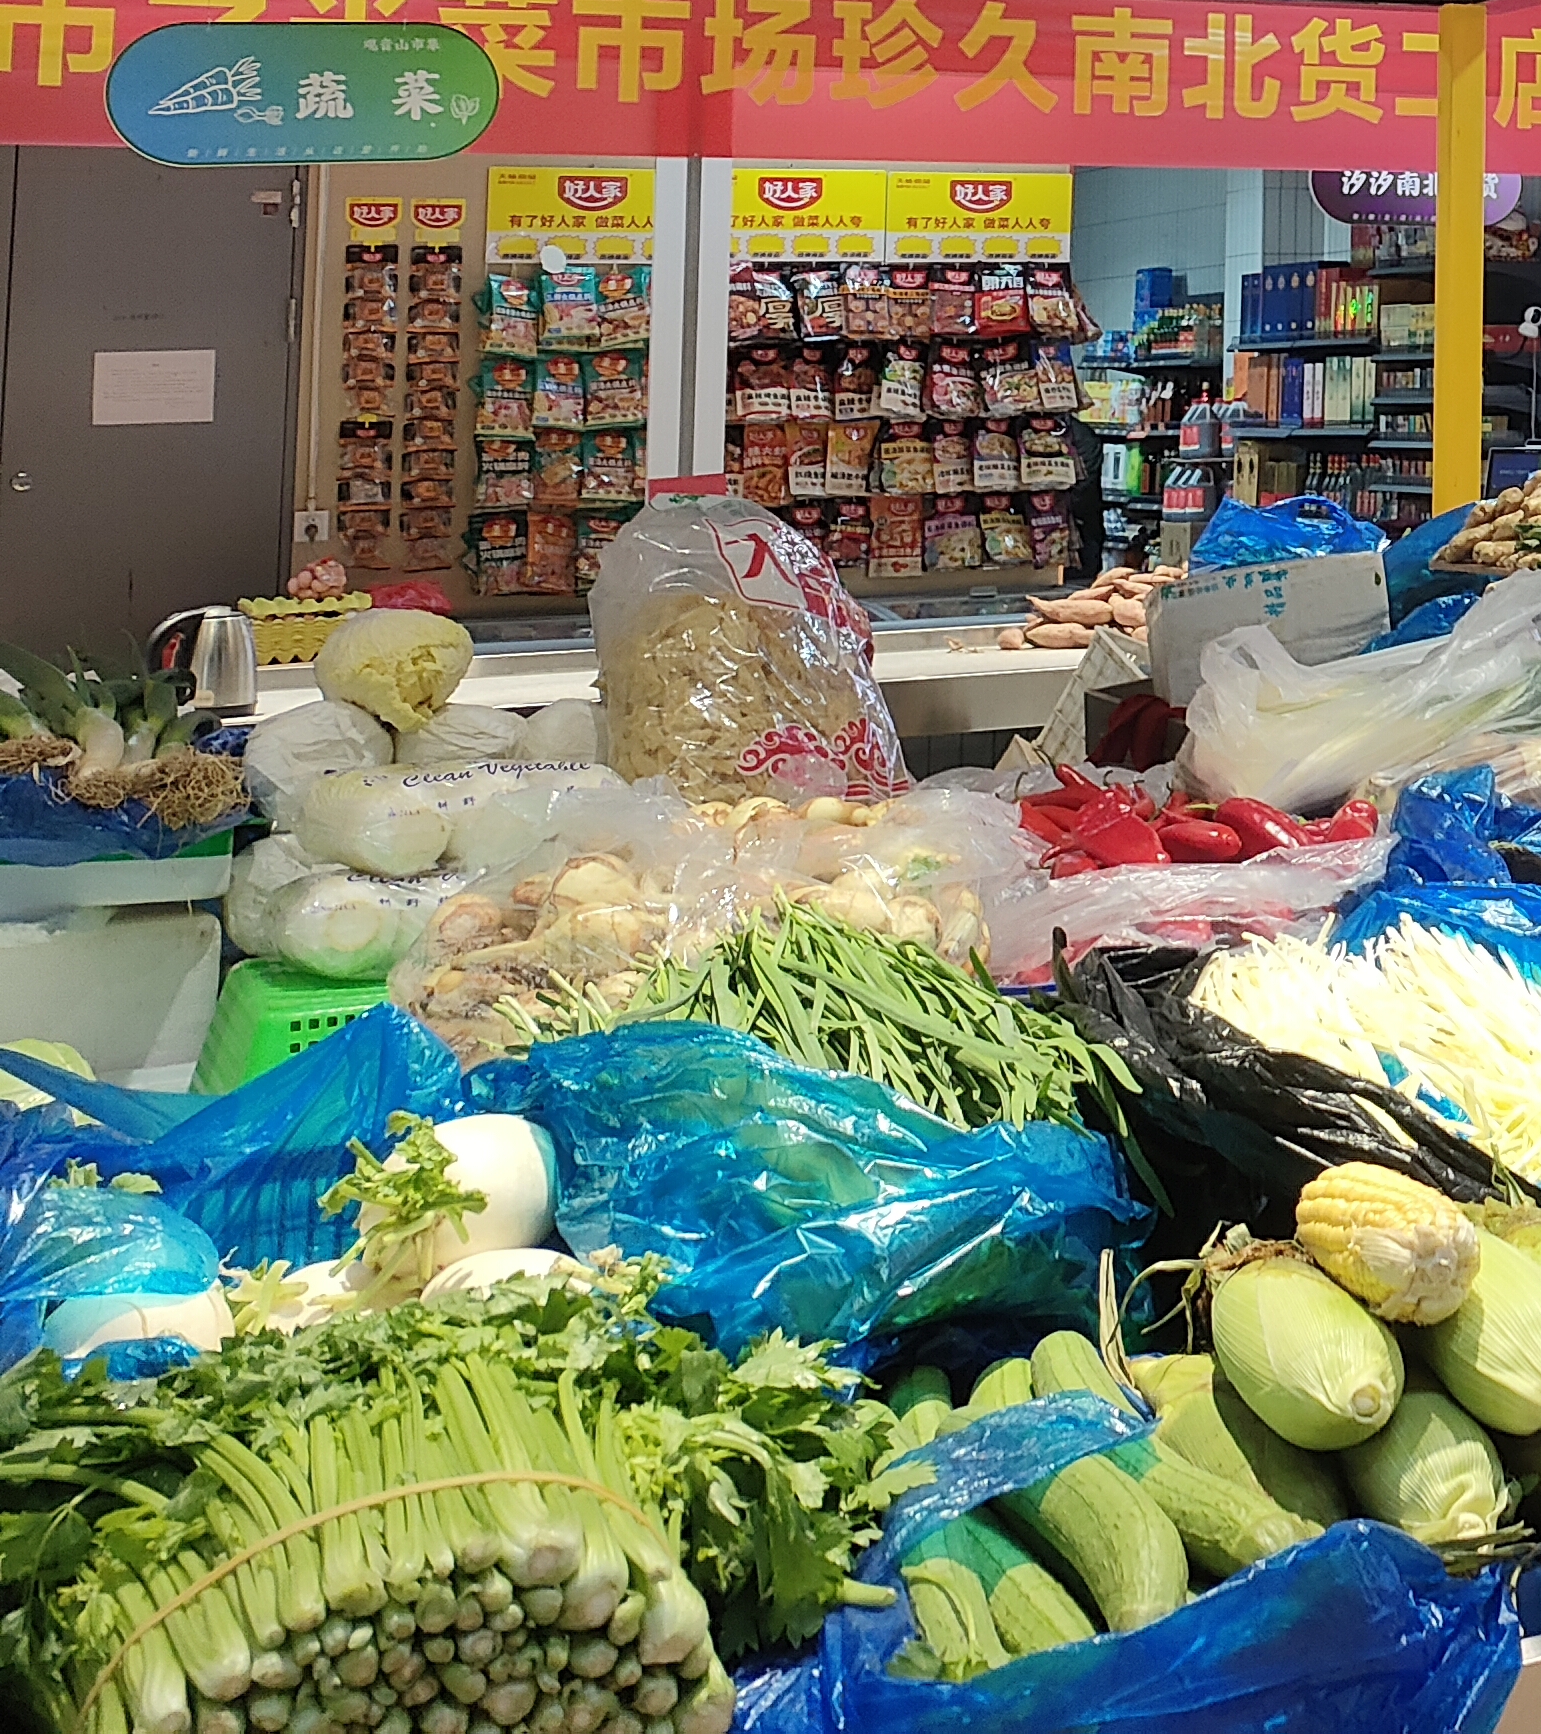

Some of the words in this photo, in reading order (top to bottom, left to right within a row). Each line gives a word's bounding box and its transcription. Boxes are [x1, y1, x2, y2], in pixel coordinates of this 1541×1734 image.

[295, 70, 445, 121] 蔬菜
[564, 180, 622, 199] 好人家
[763, 181, 818, 199] 好人家
[955, 183, 1008, 201] 好人家
[353, 205, 395, 219] 好人家
[418, 207, 459, 220] 好人家
[508, 215, 587, 229] 有了好人家
[792, 215, 863, 228] 做菜人人夸
[906, 217, 976, 230] 有了好人家
[983, 217, 1052, 230] 做菜人人夸
